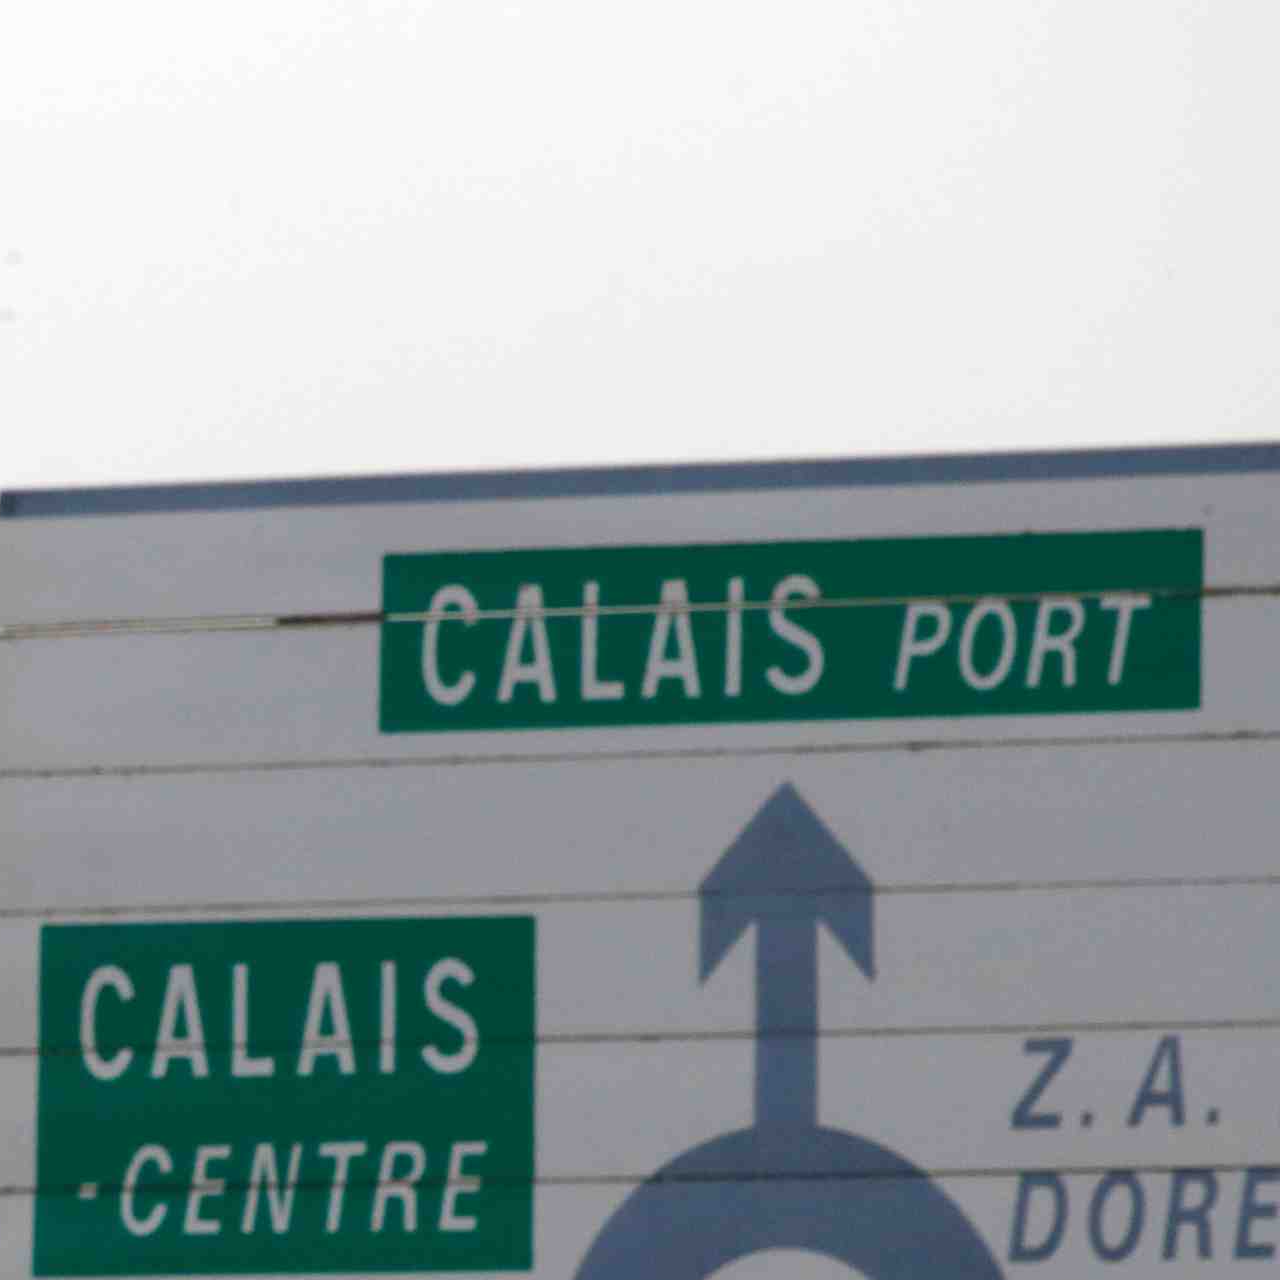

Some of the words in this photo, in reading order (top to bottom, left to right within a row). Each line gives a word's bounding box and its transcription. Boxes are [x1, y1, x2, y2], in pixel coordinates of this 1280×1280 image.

[421, 573, 825, 706] CALAIS
[893, 590, 1152, 691] PORT
[80, 957, 480, 1081] CALAIS
[1008, 1168, 1280, 1262] DORE
